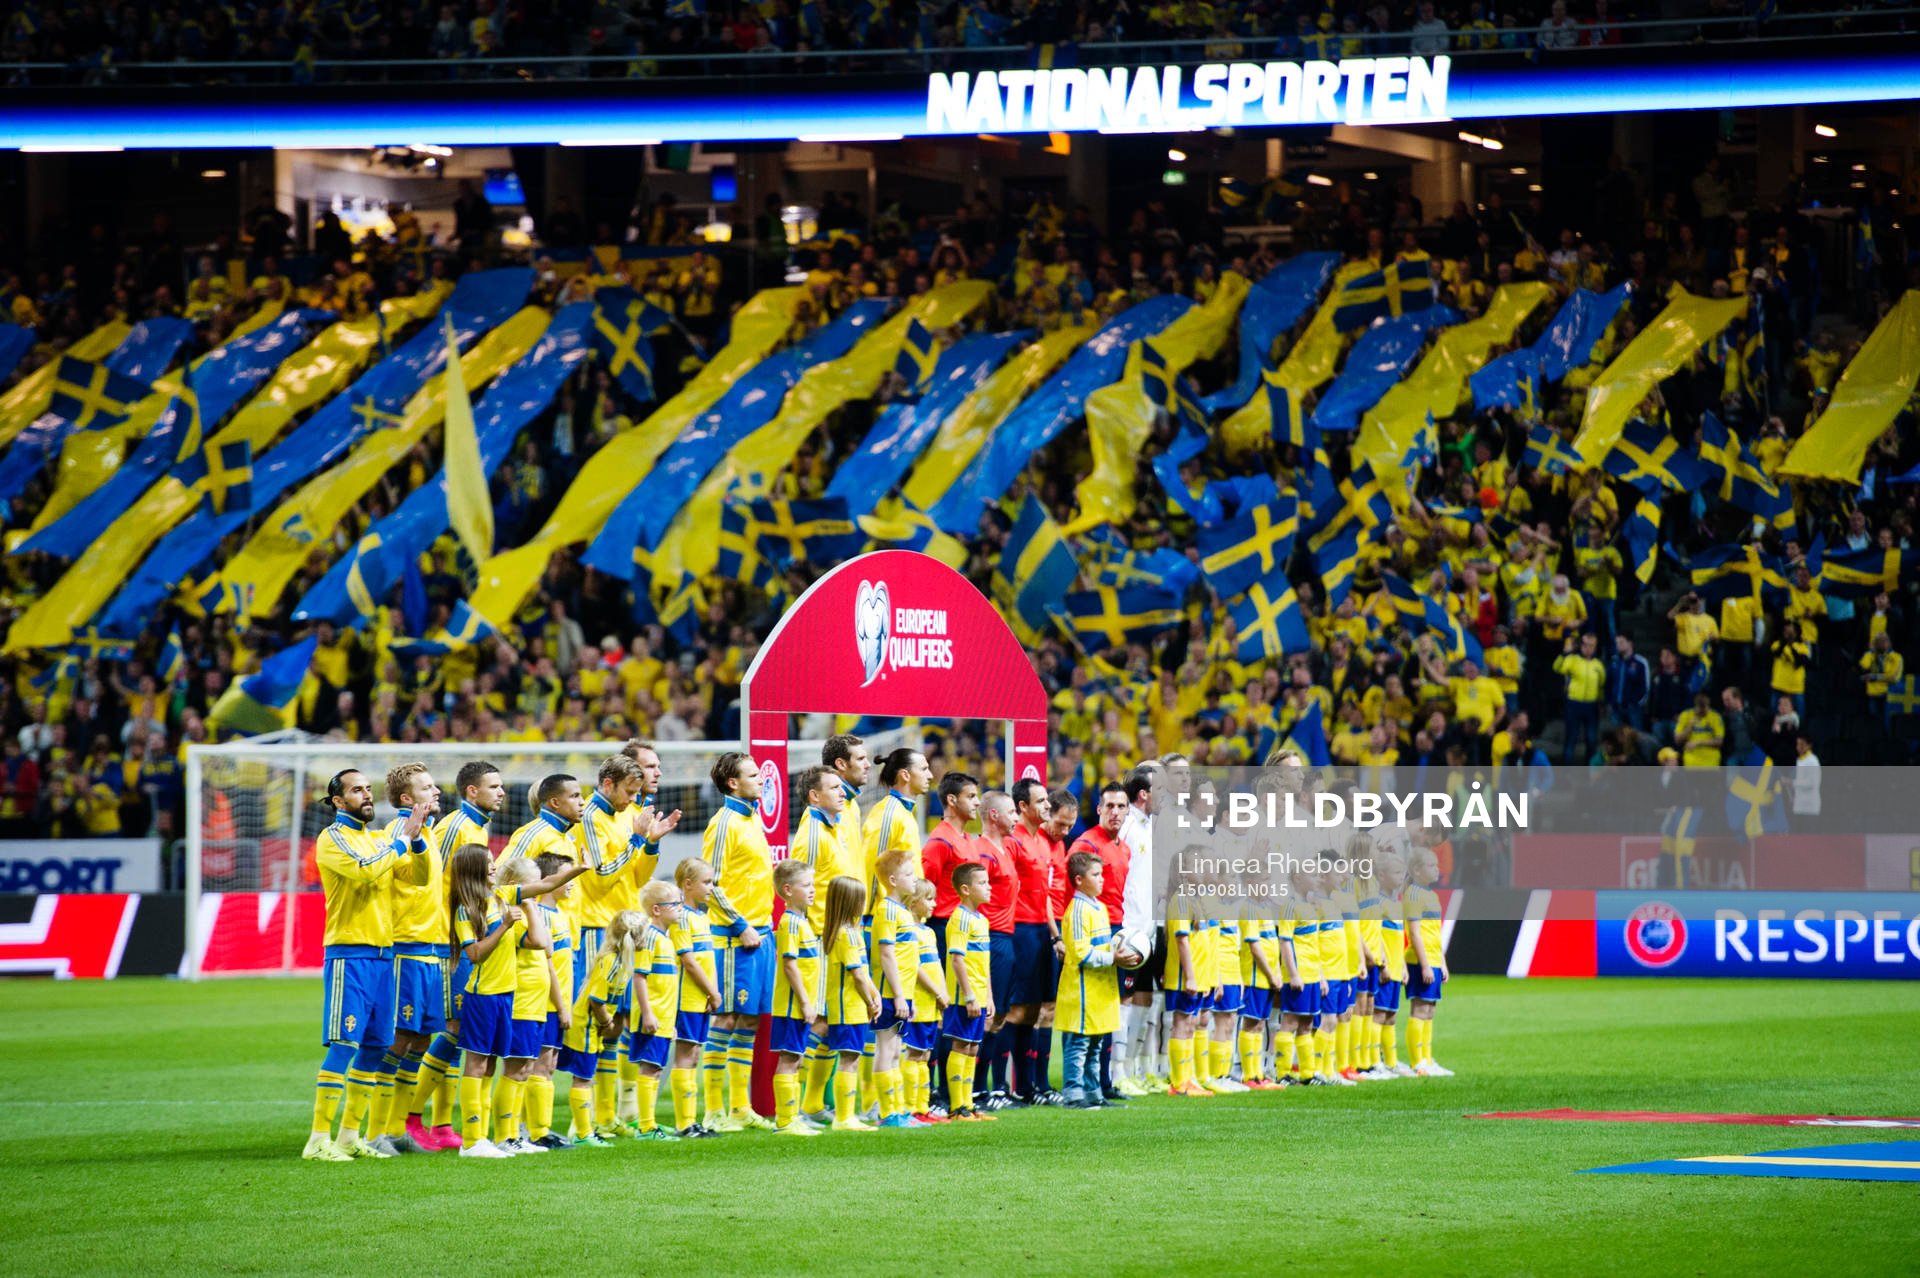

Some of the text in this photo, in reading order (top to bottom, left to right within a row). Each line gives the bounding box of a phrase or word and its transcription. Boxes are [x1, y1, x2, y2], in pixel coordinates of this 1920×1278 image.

[926, 55, 1451, 133] NATIONALSPORTEN
[896, 608, 947, 635] EUROPEAN
[889, 636, 953, 671] QUALIFIERS
